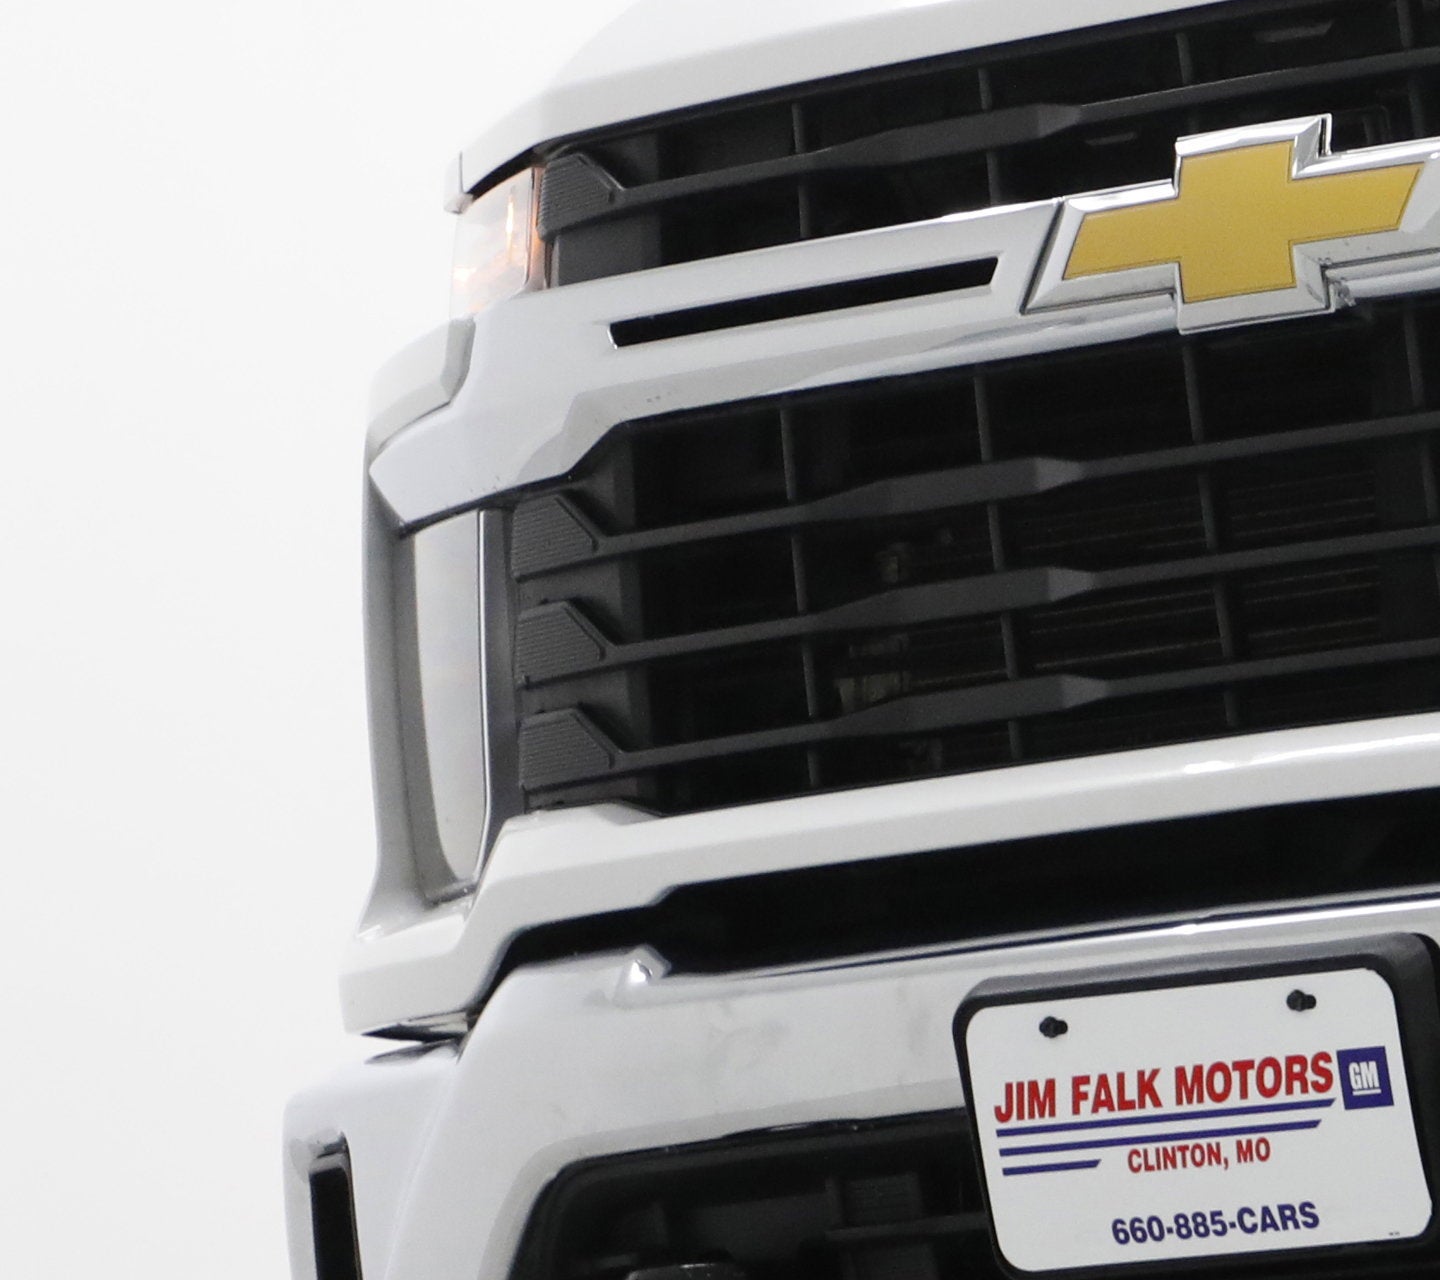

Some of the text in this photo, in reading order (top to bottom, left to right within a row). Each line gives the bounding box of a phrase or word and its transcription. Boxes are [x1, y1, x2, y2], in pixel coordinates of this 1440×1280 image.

[994, 1051, 1334, 1123] JIM FALK MOTORS
[1349, 1061, 1381, 1095] GM
[1127, 1137, 1271, 1174] CLINTON, MO
[1111, 1201, 1320, 1245] 660-885-CARS
